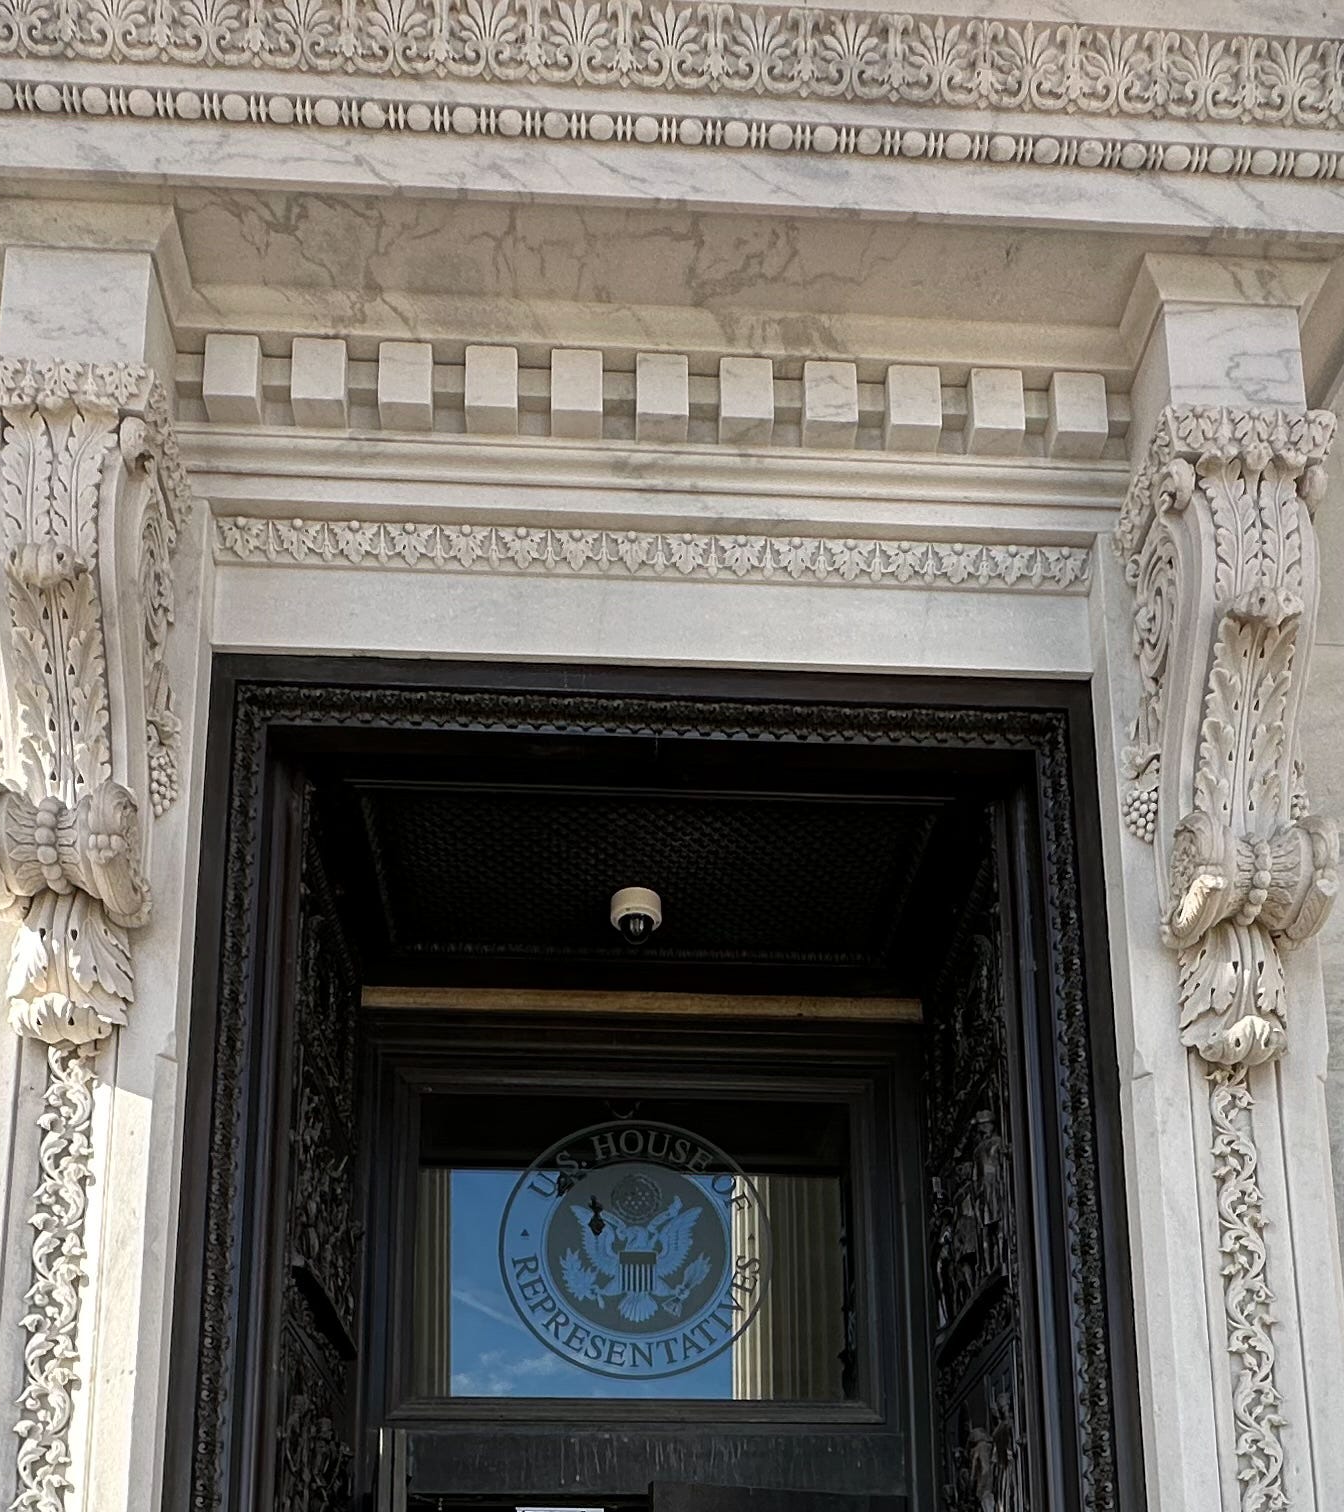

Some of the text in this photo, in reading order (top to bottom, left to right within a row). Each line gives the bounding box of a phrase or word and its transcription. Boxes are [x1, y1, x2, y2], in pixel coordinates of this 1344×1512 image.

[589, 1130, 714, 1175] HOUSE
[711, 1174, 753, 1212] OF
[512, 1254, 761, 1368] REPRESENTATIVES
